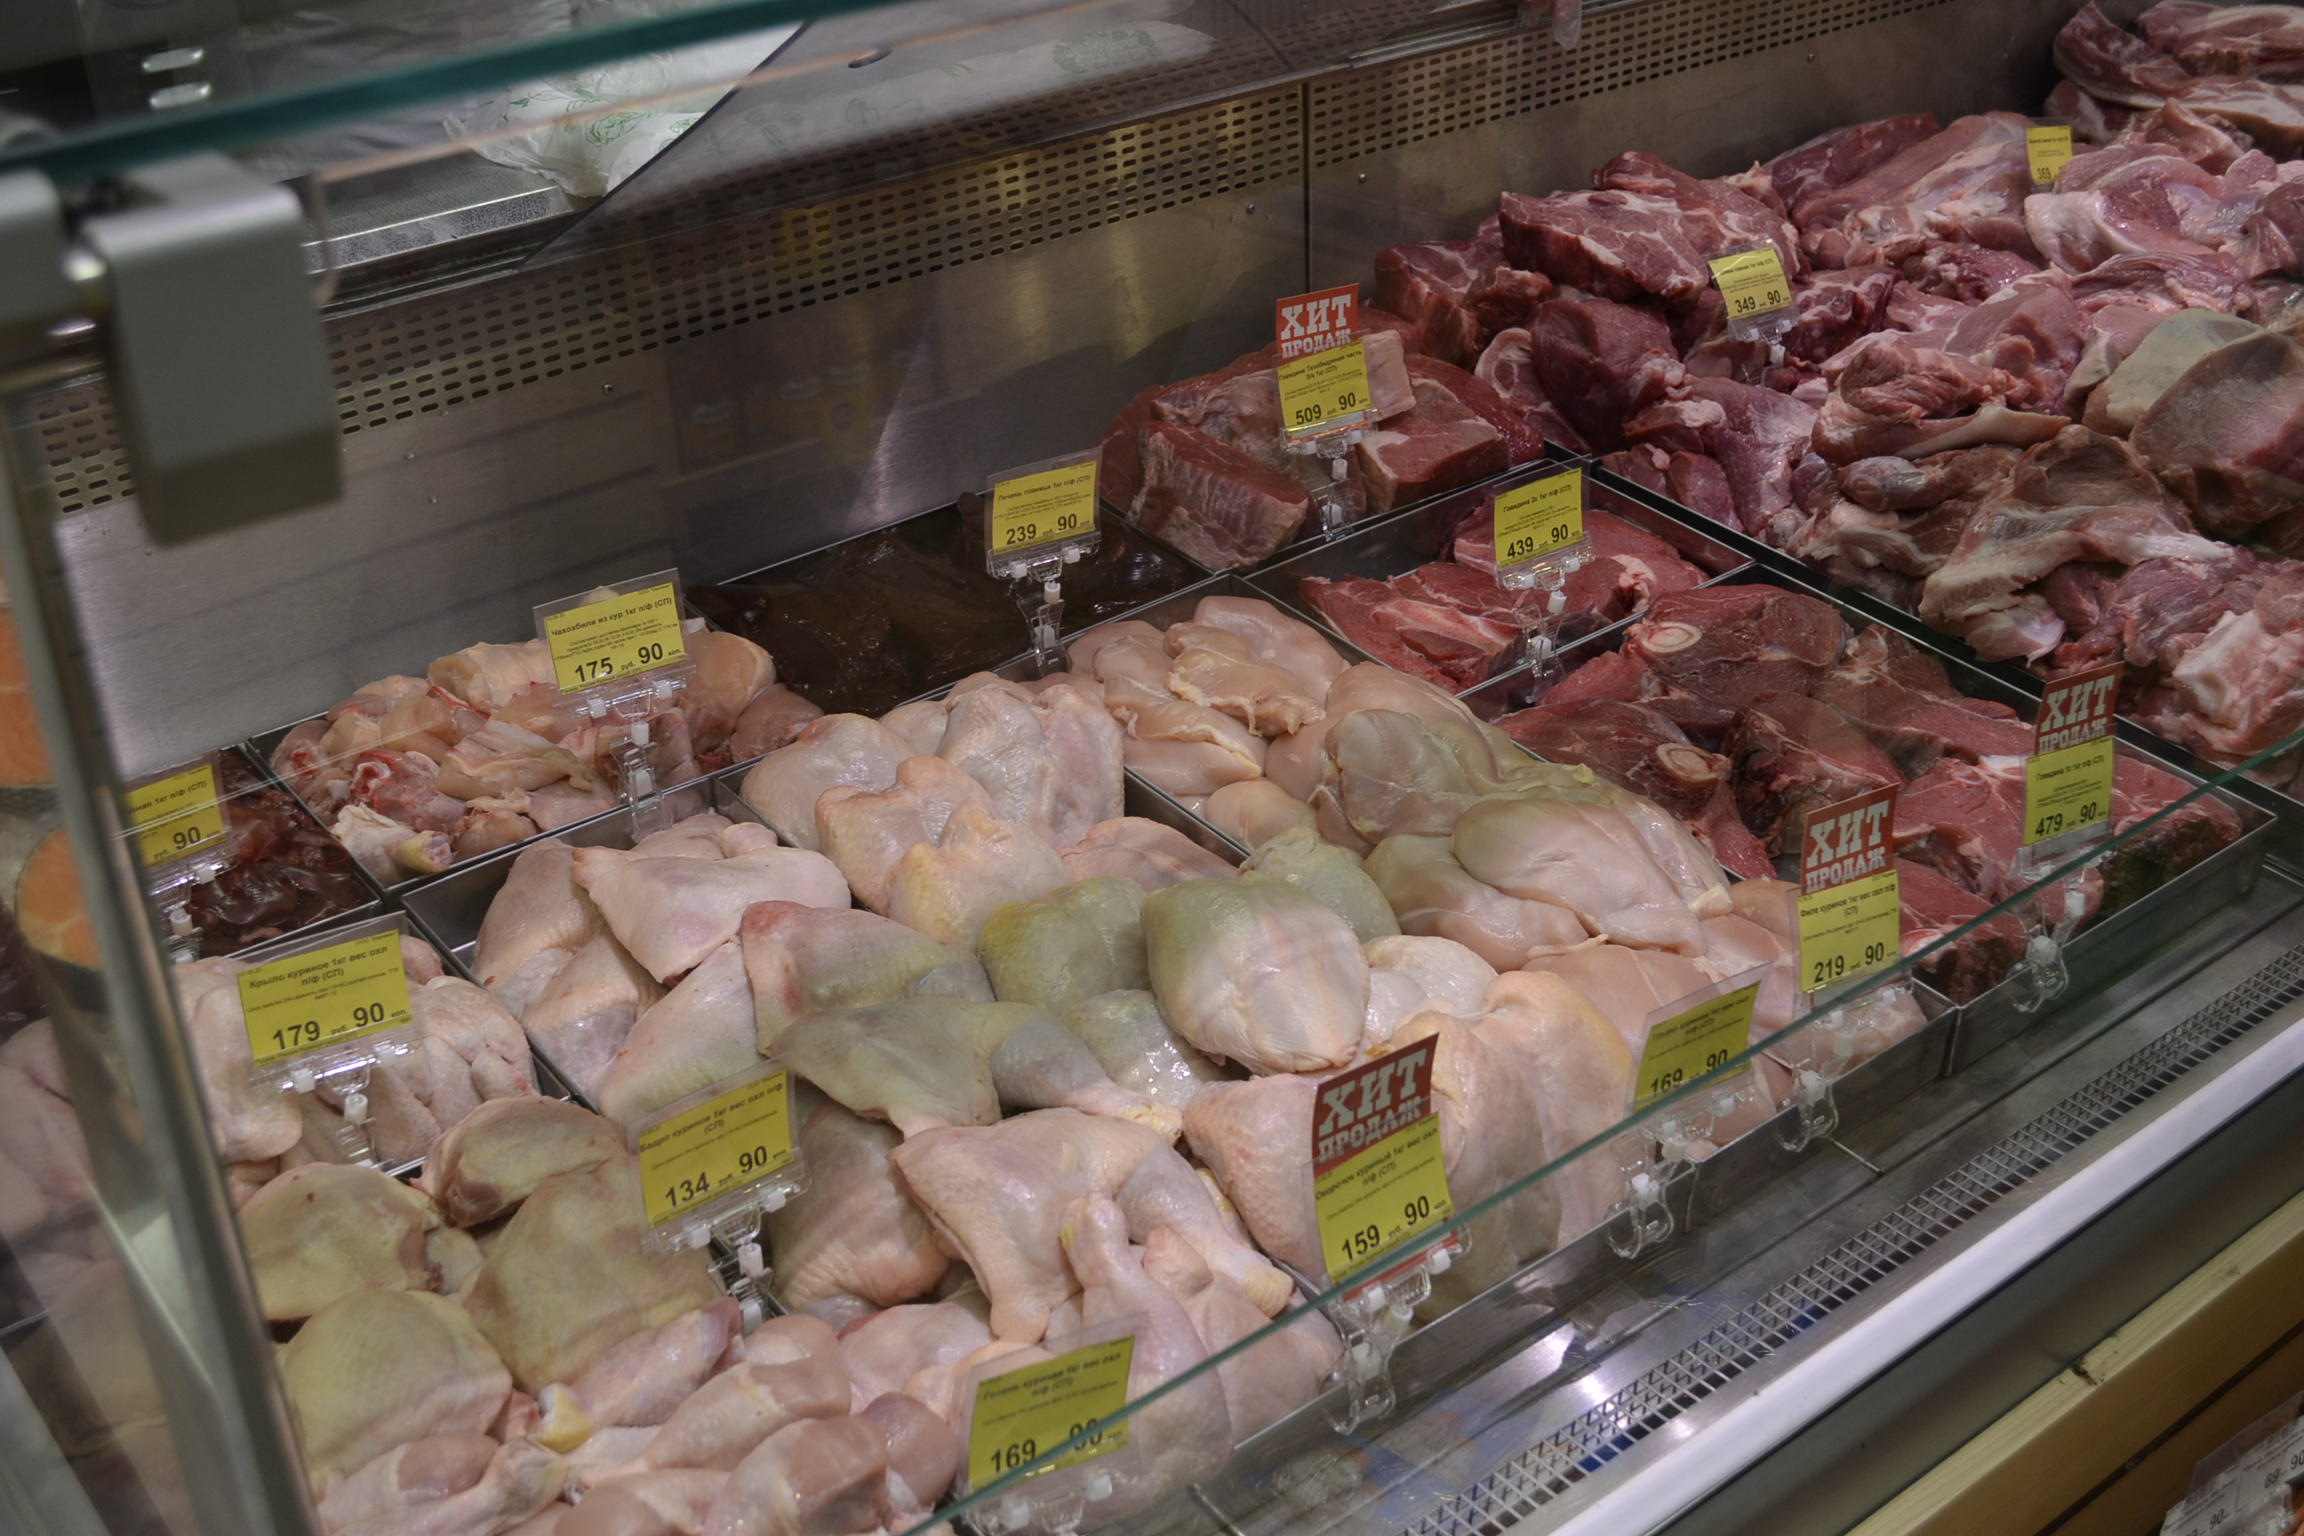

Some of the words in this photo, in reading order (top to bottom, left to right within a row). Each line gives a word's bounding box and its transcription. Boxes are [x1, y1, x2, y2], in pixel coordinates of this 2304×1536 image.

[1281, 294, 1351, 340] ХИТ
[1735, 296, 1755, 313] 349
[1767, 290, 1780, 304] 90
[1282, 328, 1351, 359] ПРОДАЖ
[1296, 404, 1321, 425] 509
[1339, 392, 1356, 410] 90
[1006, 524, 1036, 544] 239
[1058, 513, 1077, 530] 90
[1507, 537, 1533, 558] 439
[1552, 524, 1568, 543] 90
[551, 619, 596, 636] Чахохбили
[609, 611, 623, 622] кур
[625, 607, 636, 616] 1кг
[655, 597, 672, 609] (СП)
[575, 657, 613, 682] 175
[638, 643, 663, 664] 90
[2041, 675, 2115, 732] ХИТ
[2039, 718, 2107, 753] ПРОДАЖ
[188, 781, 207, 792] (СП)
[173, 826, 201, 850] 90
[1806, 800, 1890, 869] ХИТ
[2036, 813, 2063, 836] 479
[2080, 802, 2096, 823] 90
[1806, 846, 1886, 893] ПРОДАЖ
[250, 974, 285, 989] Крыло
[288, 962, 329, 979] куриное
[333, 958, 346, 967] 1кг
[349, 953, 366, 962] вес
[370, 946, 387, 956] охл
[323, 968, 344, 981] (СП)
[1814, 955, 1844, 983] 219
[1865, 942, 1884, 965] 90
[273, 1021, 320, 1050] 179
[353, 1003, 384, 1027] 90
[1319, 1048, 1427, 1136] ХИТ
[1650, 1068, 1683, 1096] 169
[1707, 1049, 1728, 1072] 90
[672, 1115, 711, 1137] куриное
[714, 1107, 727, 1117] 1кг
[729, 1100, 745, 1111] вес
[748, 1090, 764, 1103] охл
[704, 1119, 725, 1135] (СП)
[1319, 1096, 1421, 1162] ПРОДАЖ
[665, 1171, 709, 1207] 134
[739, 1146, 767, 1174] 90
[1316, 1175, 1354, 1200] Окорочок
[1407, 1136, 1421, 1148] вес
[1378, 1162, 1396, 1178] (СП)
[1342, 1224, 1380, 1260] 159
[1405, 1195, 1429, 1225] 90
[991, 1438, 1037, 1473] 169
[1070, 1418, 1102, 1450] 90
